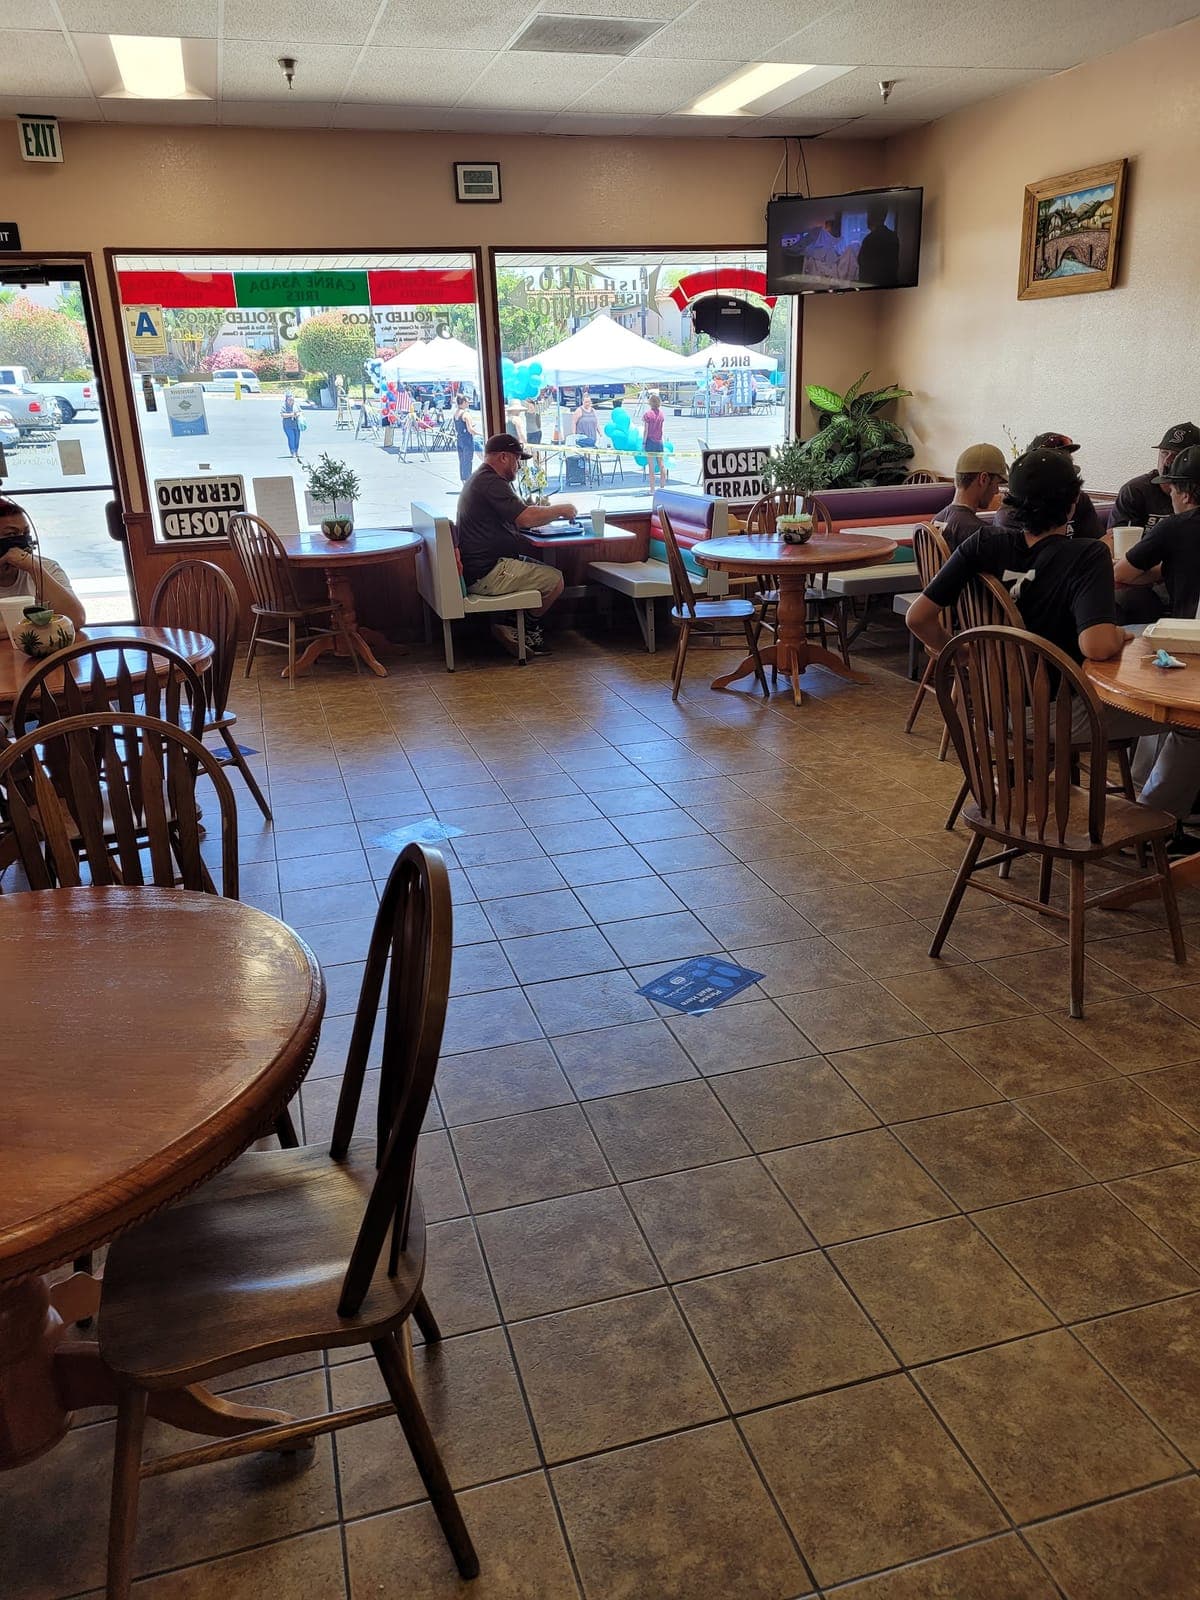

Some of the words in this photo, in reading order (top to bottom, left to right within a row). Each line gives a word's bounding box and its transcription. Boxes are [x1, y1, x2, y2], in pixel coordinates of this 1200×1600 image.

[22, 123, 57, 157] EXIT
[136, 312, 158, 337] A
[158, 482, 241, 506] CERRADO
[165, 509, 238, 537] LOSED
